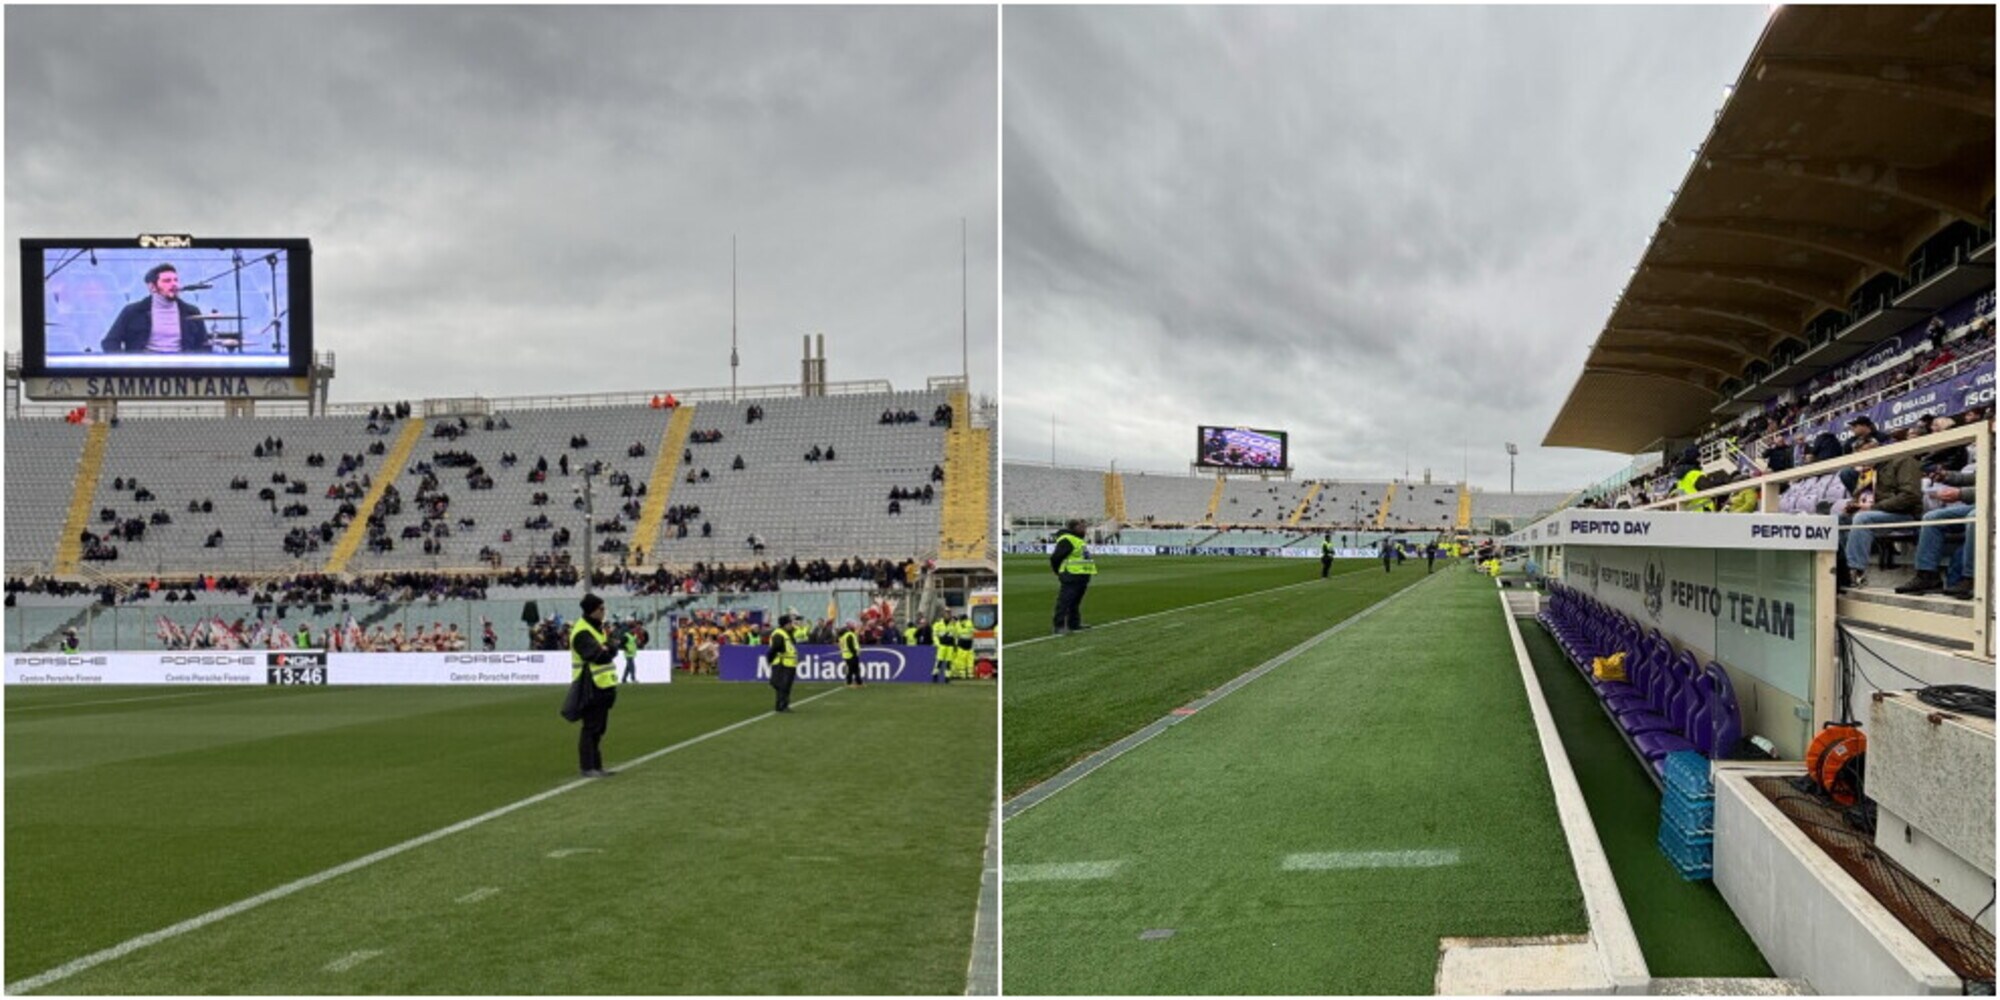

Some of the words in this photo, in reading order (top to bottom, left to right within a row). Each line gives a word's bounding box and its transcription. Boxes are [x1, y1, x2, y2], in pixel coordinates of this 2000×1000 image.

[87, 376, 250, 396] SAMMONTANA
[1571, 520, 1620, 534] PEPITO
[1623, 521, 1651, 535] DAY
[1751, 524, 1800, 538] PEPITO
[1805, 526, 1832, 539] DAY
[1671, 579, 1721, 617] PEPITO
[1727, 591, 1795, 641] TEAM
[14, 656, 107, 666] PORSCHE
[161, 656, 255, 666] PORSCHE
[444, 654, 544, 664] PORSCHE
[273, 668, 322, 685] 13:46
